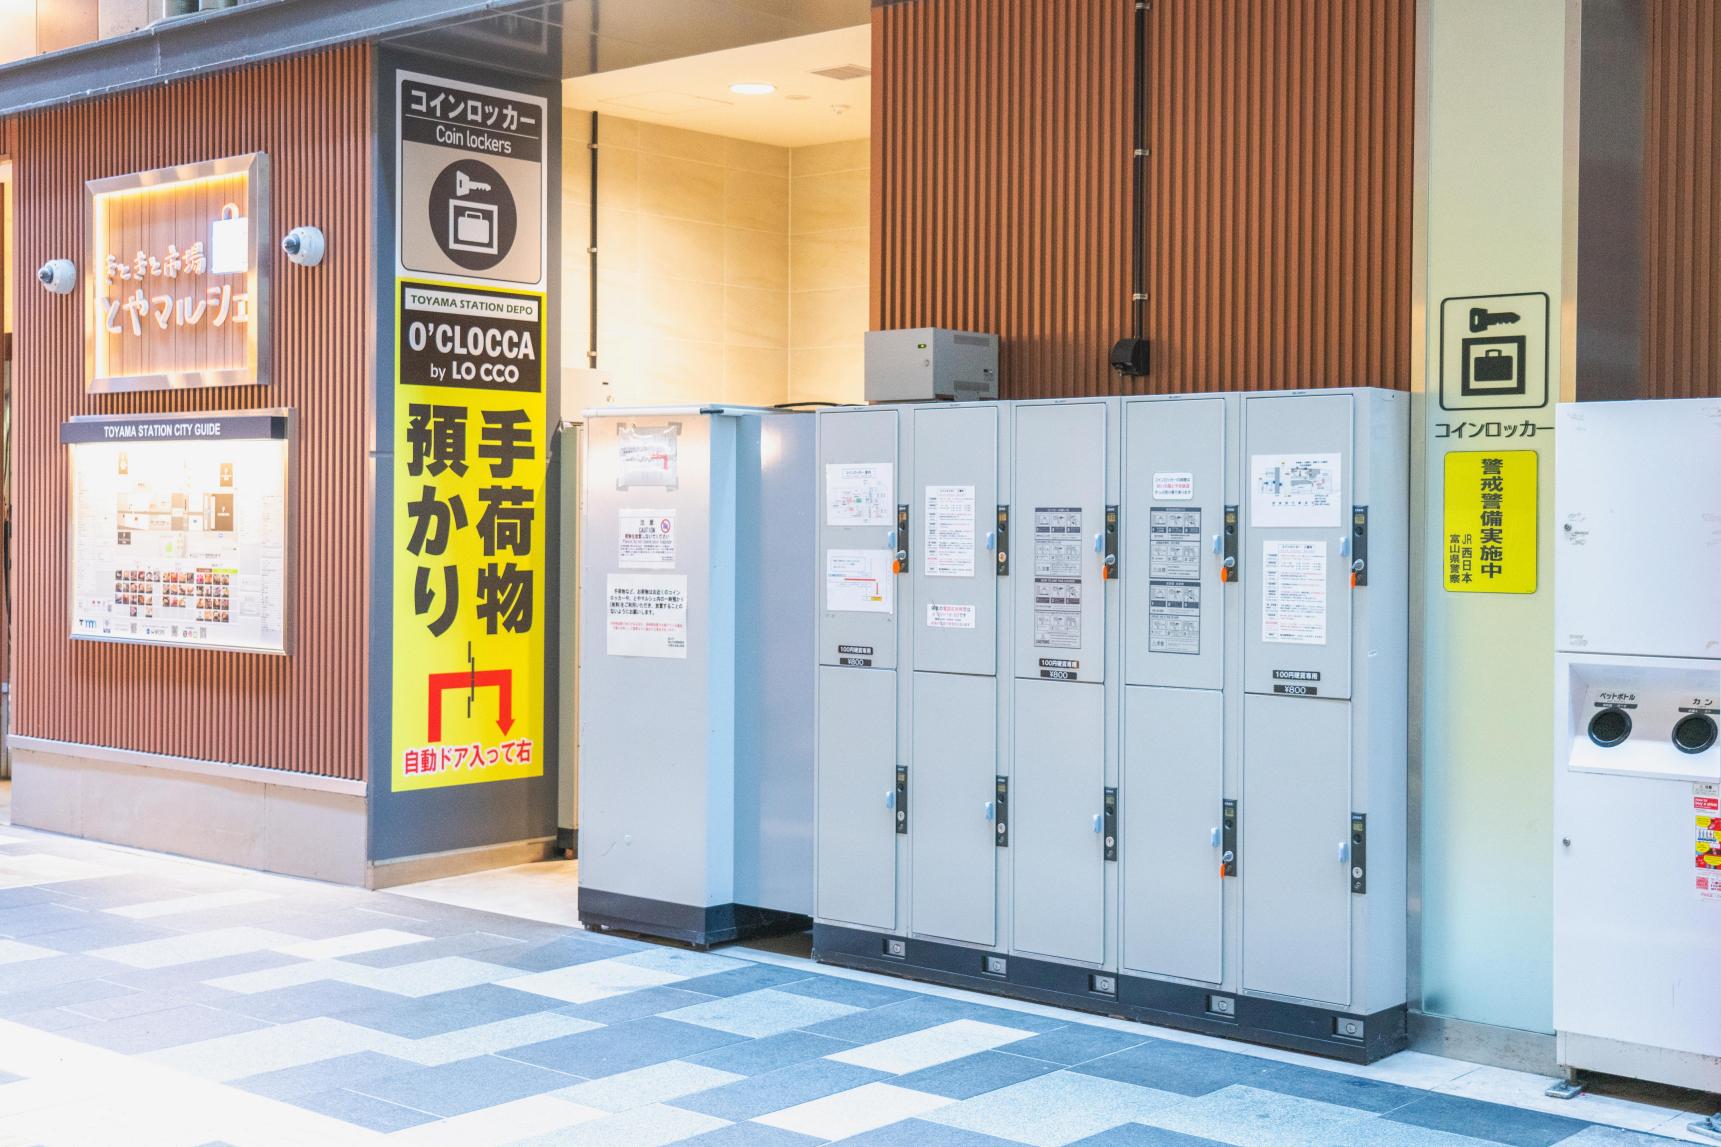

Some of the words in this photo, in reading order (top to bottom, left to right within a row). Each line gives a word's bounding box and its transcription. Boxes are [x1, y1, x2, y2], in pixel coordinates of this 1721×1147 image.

[411, 90, 535, 130] コインロッカー
[436, 125, 464, 146] Coin
[467, 130, 512, 153] lockers
[102, 284, 249, 336] とやマルシェ
[411, 295, 458, 308] TOYAMA
[460, 299, 504, 312] STATION
[506, 304, 533, 315] DEPO
[409, 321, 535, 360] O'CLOCCA
[430, 363, 446, 381] by
[104, 424, 137, 438] TOYAMA
[139, 423, 172, 437] STATION
[174, 423, 193, 436] CITY
[194, 423, 221, 436] GUIDE
[1435, 420, 1554, 438] コインロッカー
[407, 403, 469, 637] 預かり
[477, 409, 535, 635] 手荷物
[1480, 458, 1504, 579] 警戒警備実施中
[1449, 534, 1461, 583] 富山県警察
[1461, 534, 1473, 583] JR西日本
[1284, 685, 1306, 694] ¥800
[1600, 692, 1635, 700] ペットボトル
[1692, 698, 1713, 706] カン
[405, 740, 532, 774] 自動ドア入って右
